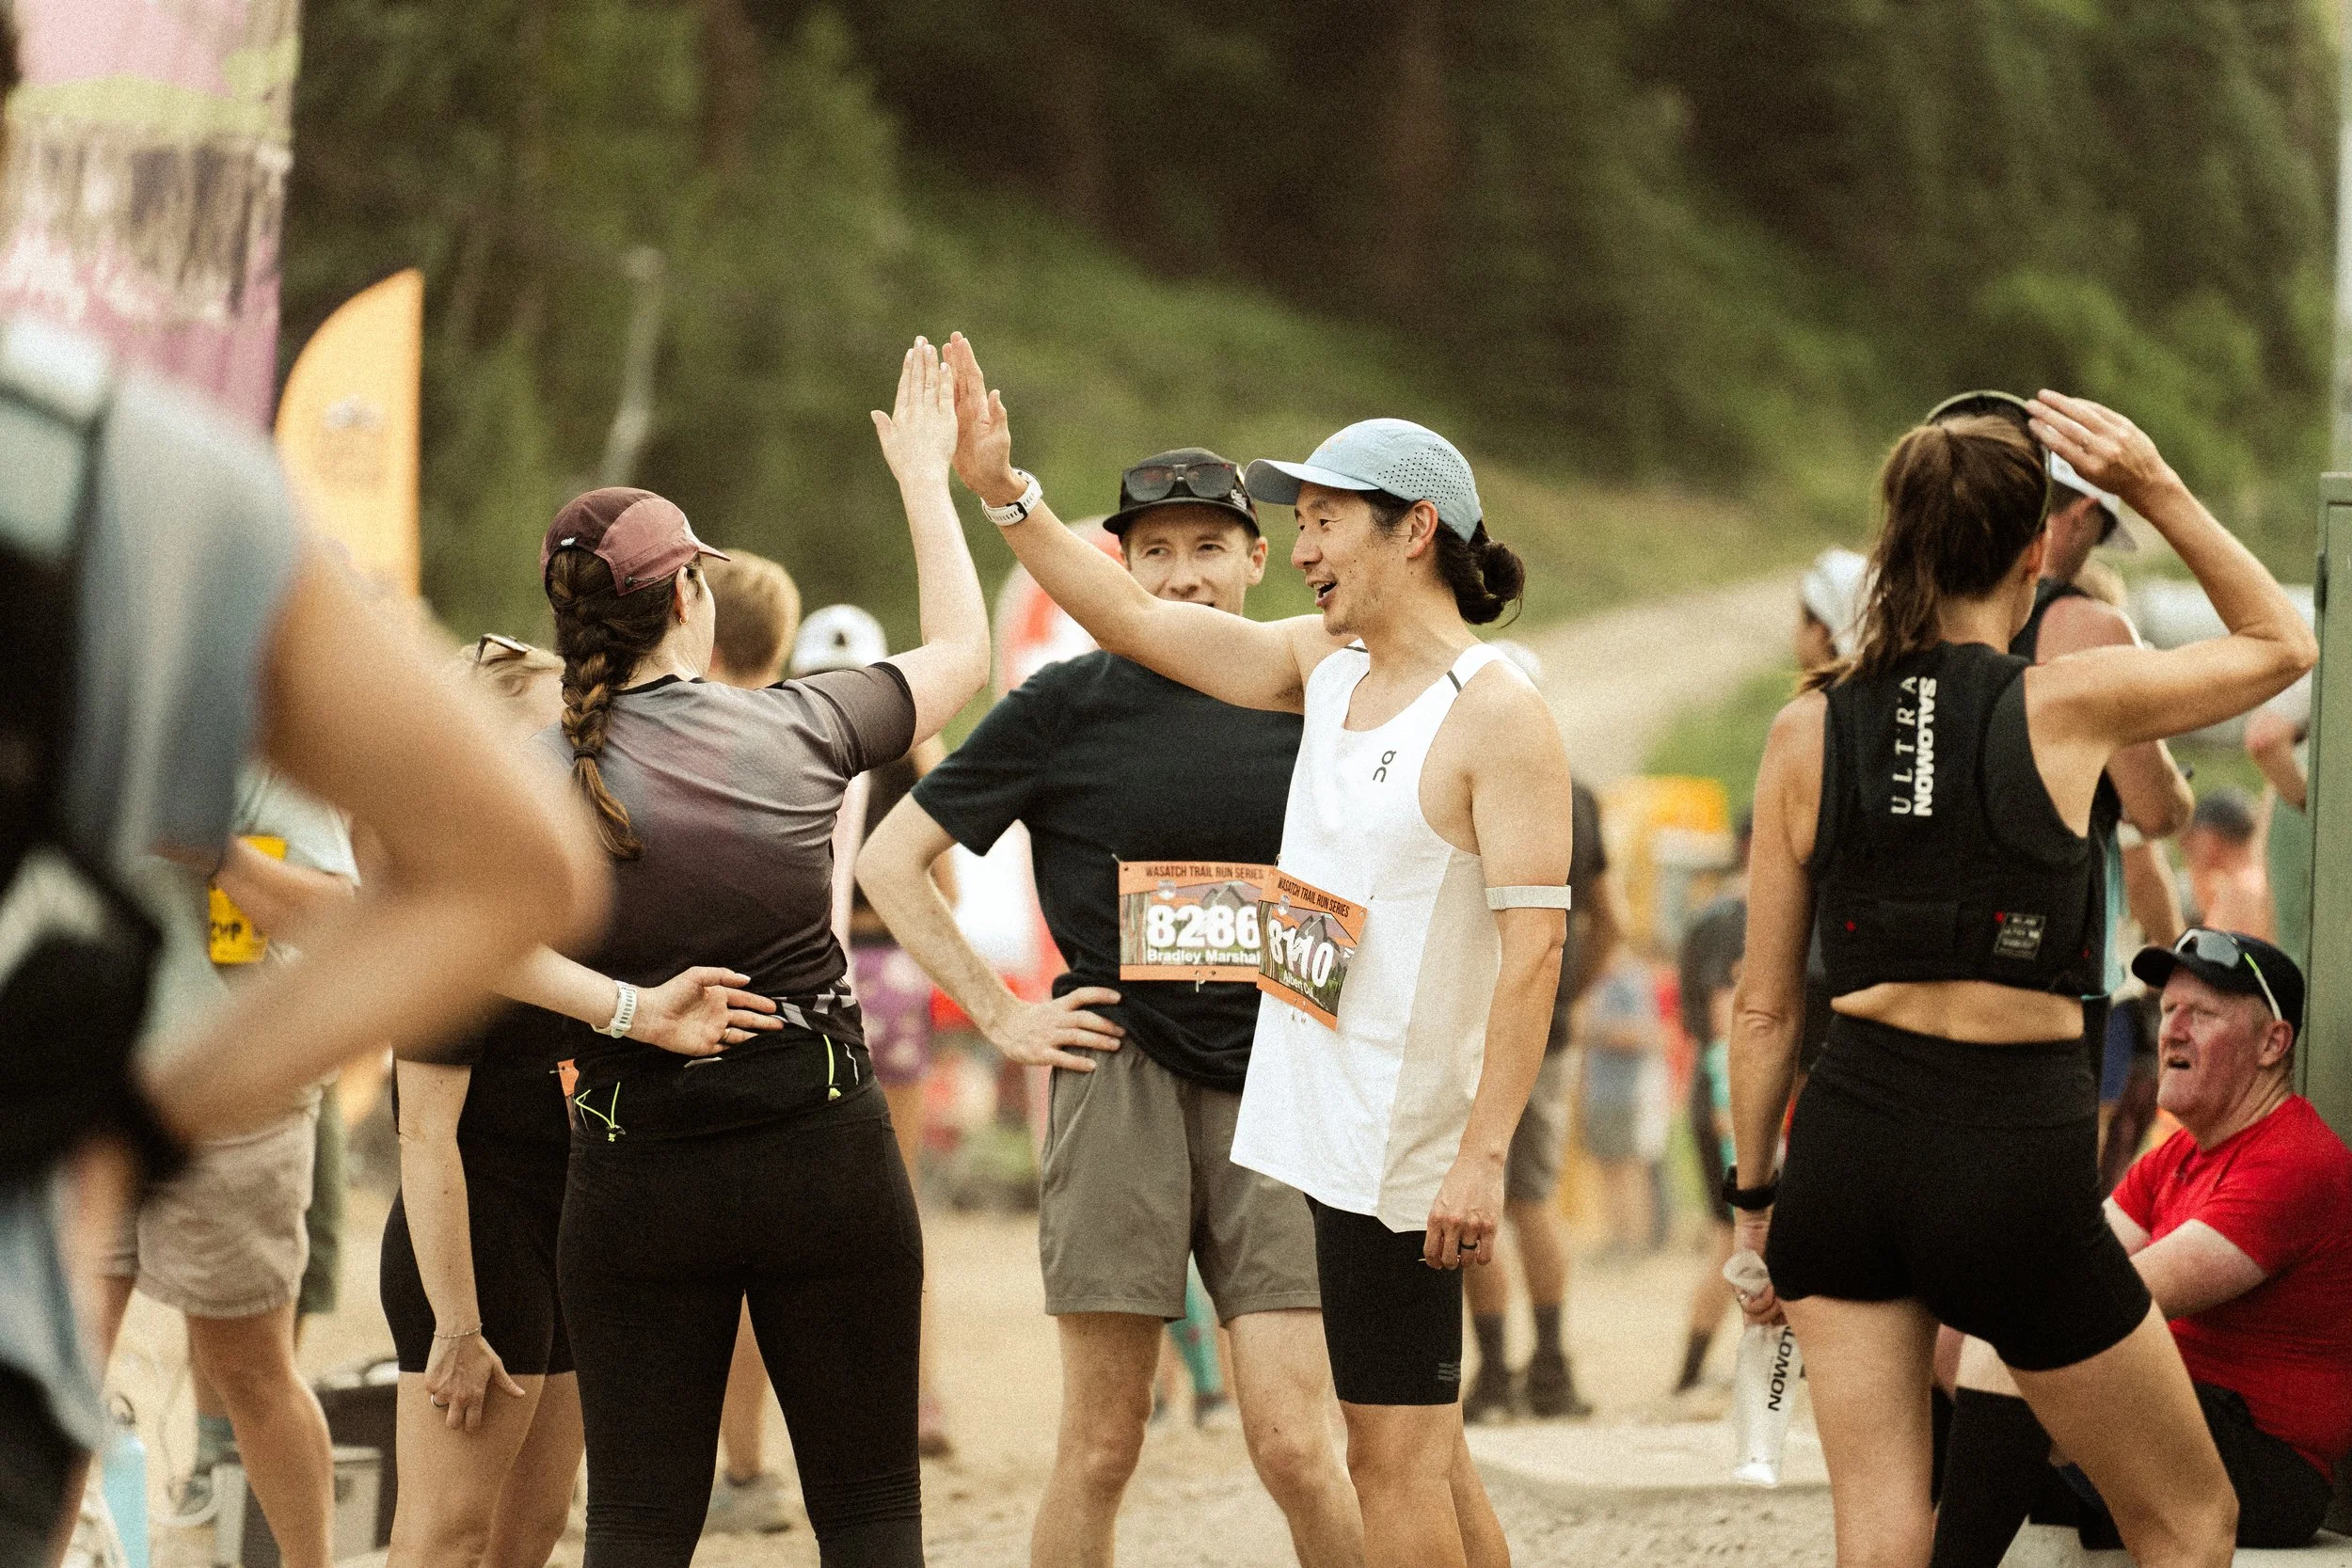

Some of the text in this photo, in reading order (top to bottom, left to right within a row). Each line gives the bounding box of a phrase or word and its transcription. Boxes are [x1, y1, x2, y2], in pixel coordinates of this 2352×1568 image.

[1891, 676, 1917, 815] ULTRA
[1913, 676, 1937, 816] SALOMON
[1146, 865, 1263, 879] WASATCH TRAIL RUN SERIES
[1277, 877, 1350, 918] WASATCH TRAIL RUN SERIES
[1147, 904, 1261, 949] 8286
[1268, 919, 1334, 988] 8110
[1147, 948, 1201, 965] Bradley
[1768, 1325, 1796, 1412] LOMON
